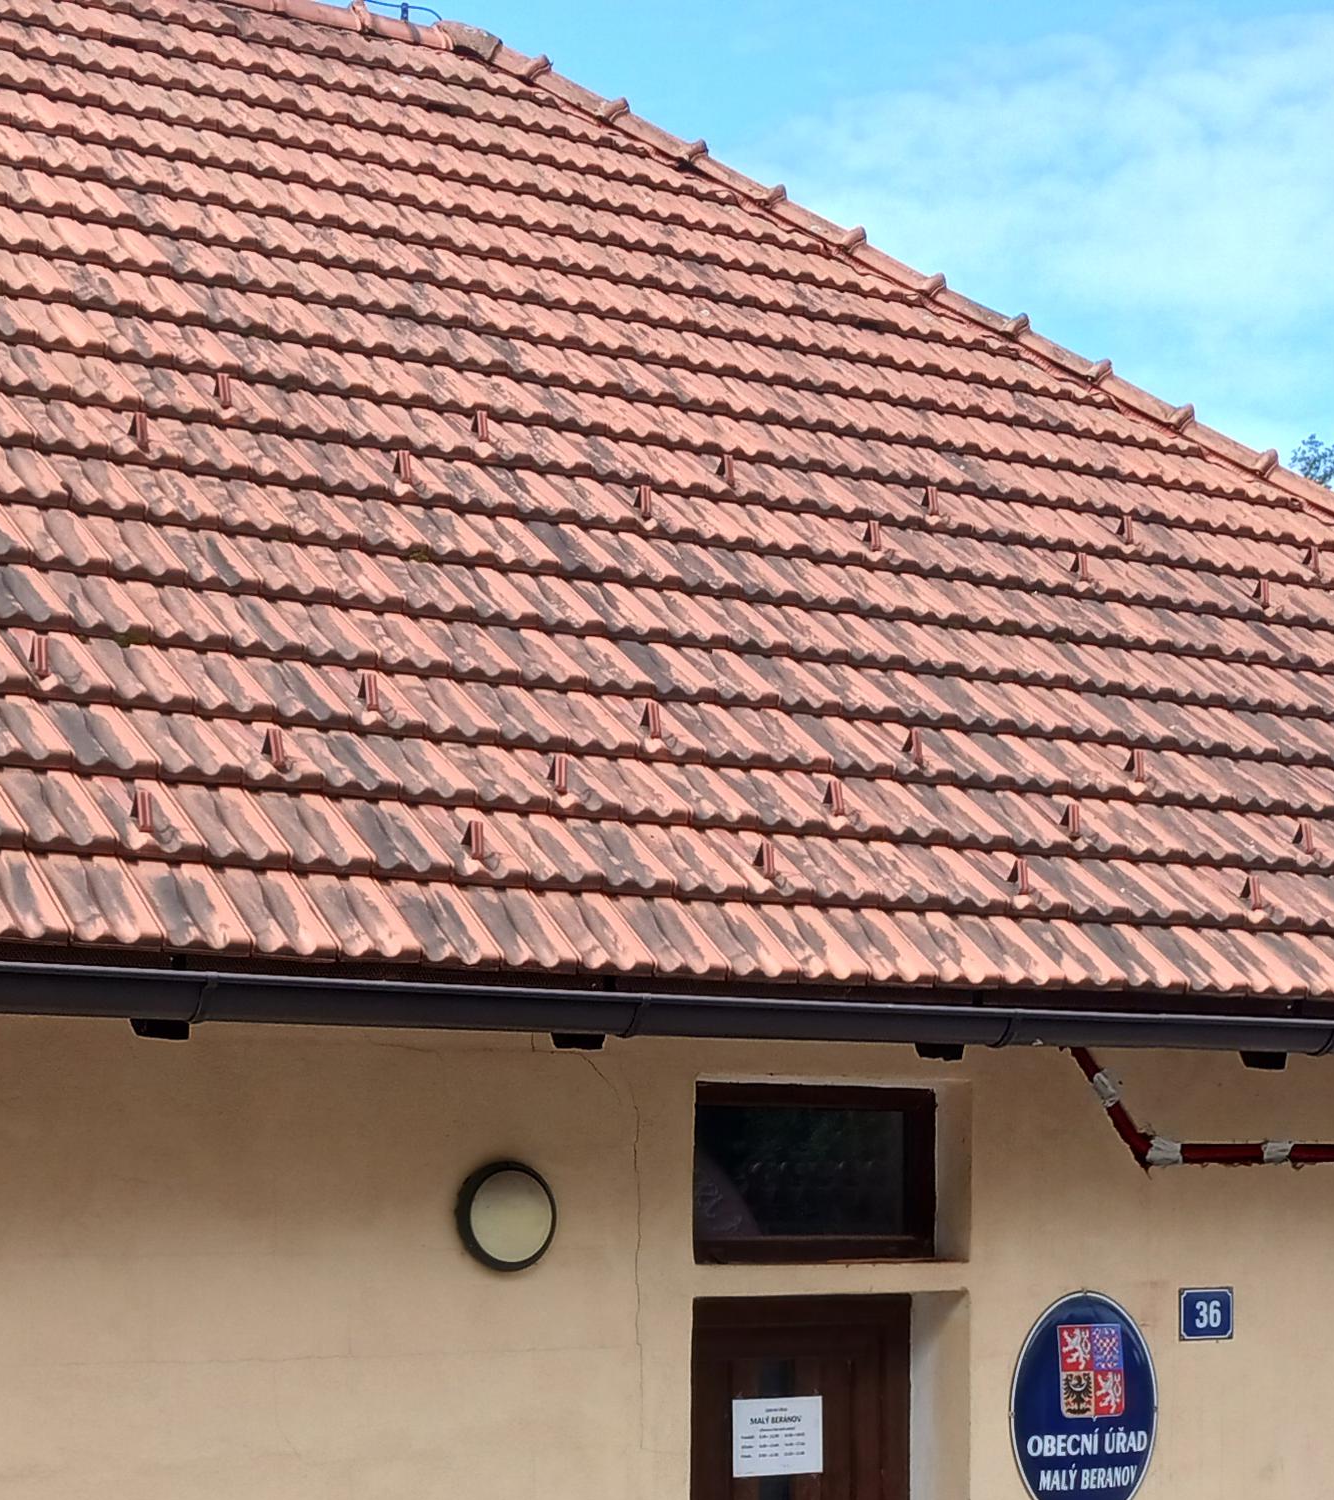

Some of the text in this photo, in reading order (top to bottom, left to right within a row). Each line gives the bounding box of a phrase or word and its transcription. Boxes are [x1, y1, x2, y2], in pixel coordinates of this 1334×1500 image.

[1195, 1300, 1222, 1328] 36
[1027, 1427, 1148, 1457] OBECNÍ ÚŘAD
[1038, 1464, 1138, 1491] MALÝ BERANOV
